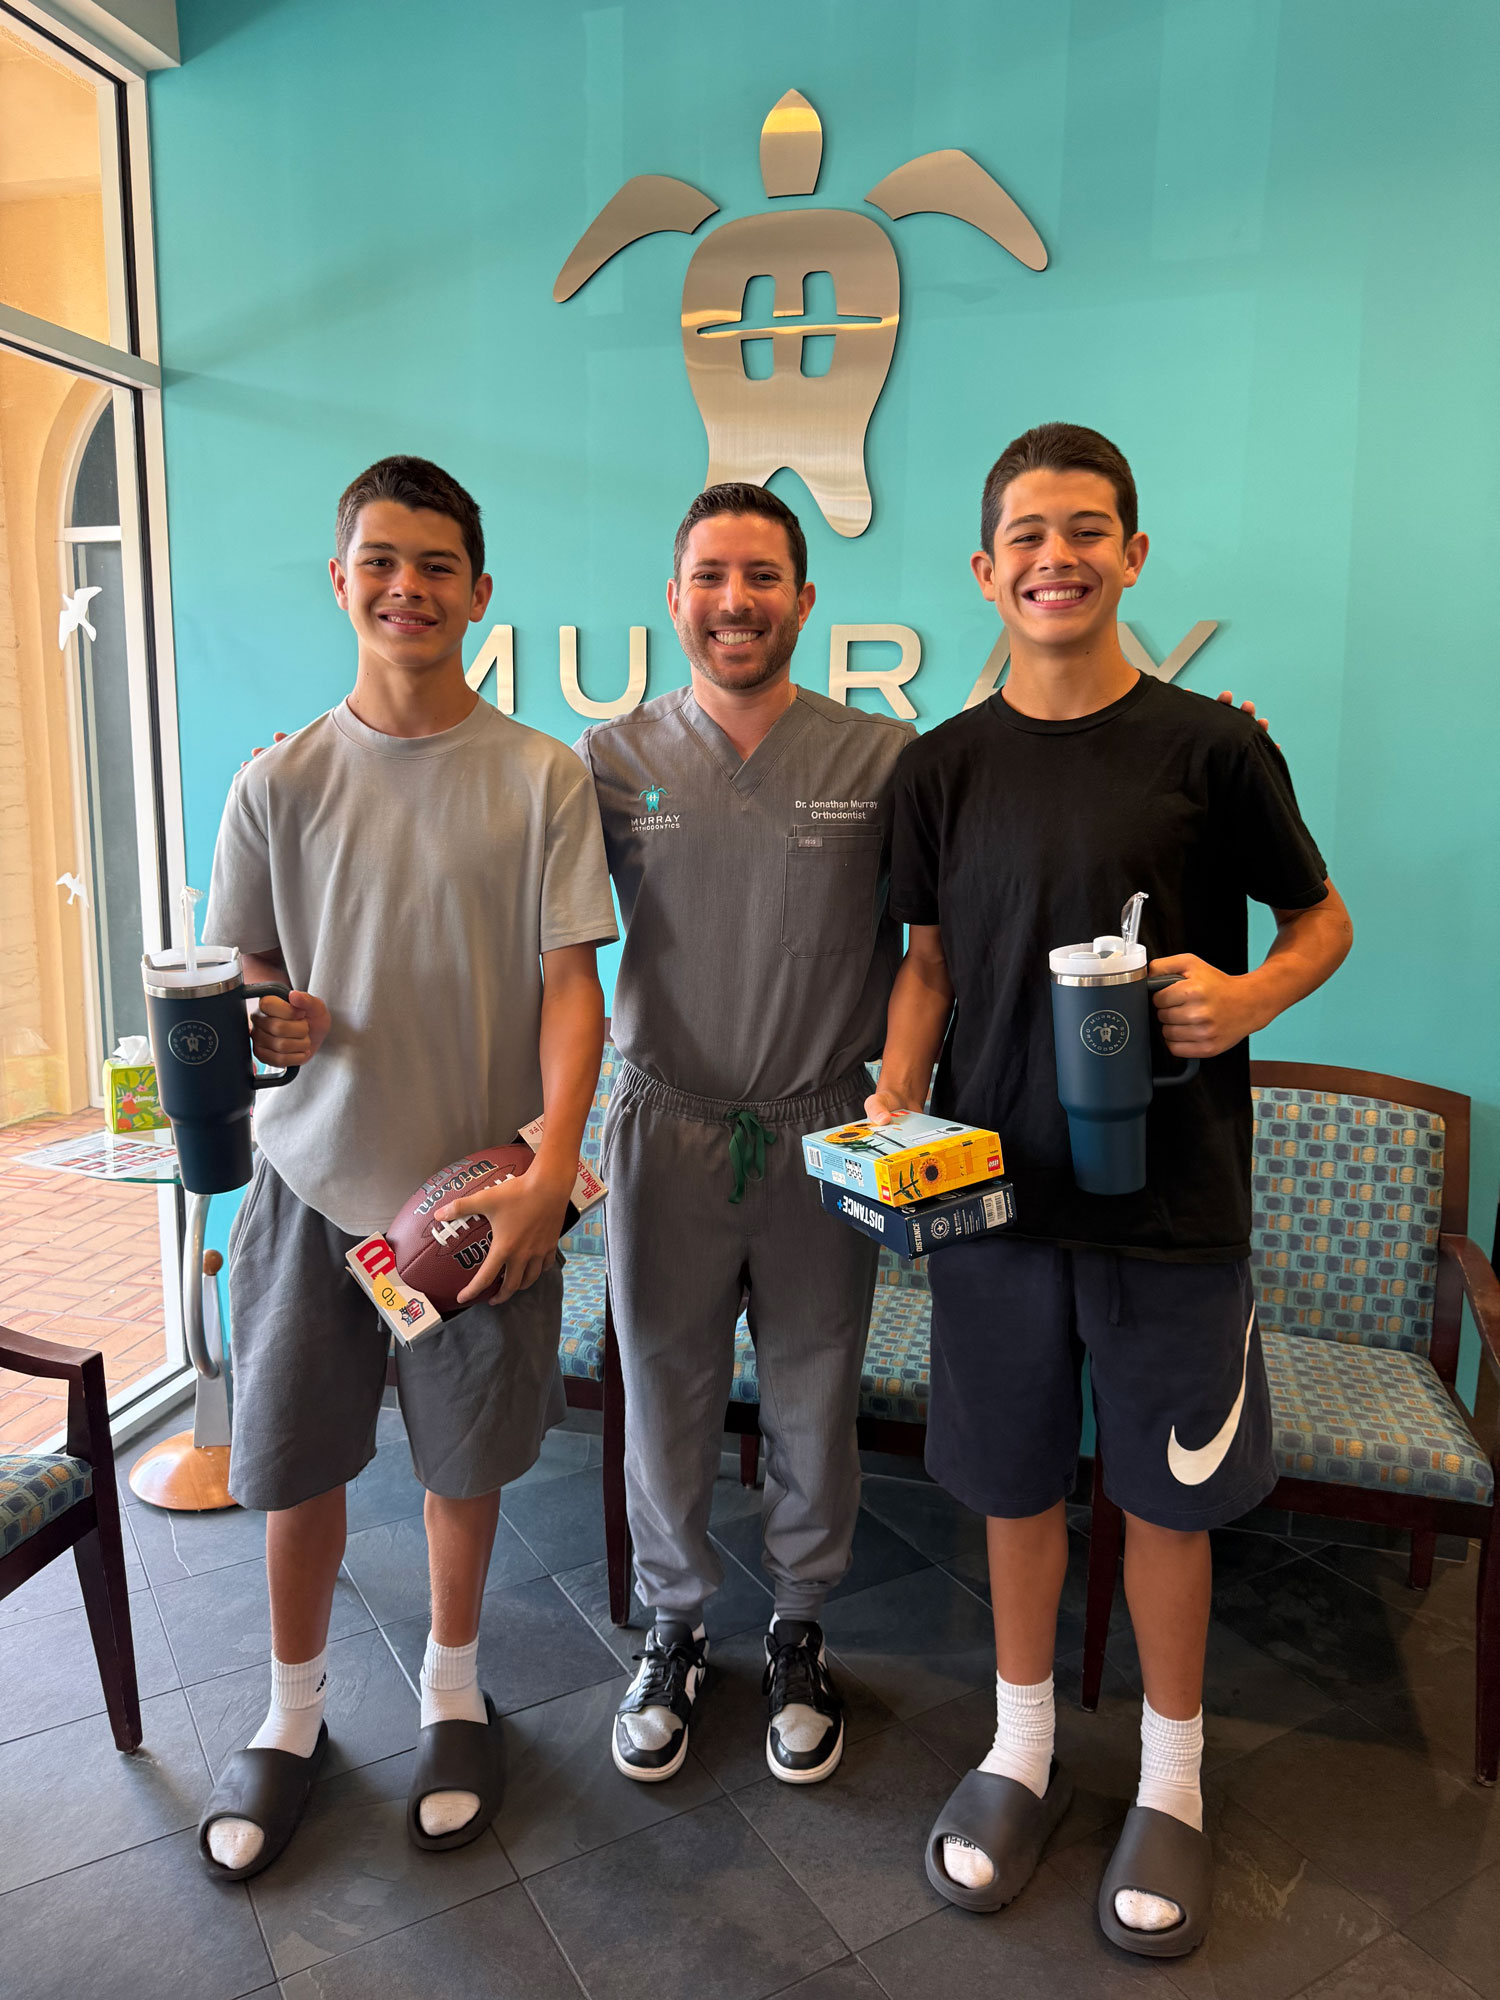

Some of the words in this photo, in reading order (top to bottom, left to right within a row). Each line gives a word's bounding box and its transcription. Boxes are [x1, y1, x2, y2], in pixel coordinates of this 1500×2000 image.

[809, 800, 848, 808] Jonathan
[851, 800, 878, 809] Murray
[631, 815, 680, 826] MURRAY
[811, 811, 866, 819] Orthodontist
[413, 1159, 499, 1215] Wilson
[580, 1169, 602, 1195] BRONZE
[581, 1185, 595, 1199] NFL
